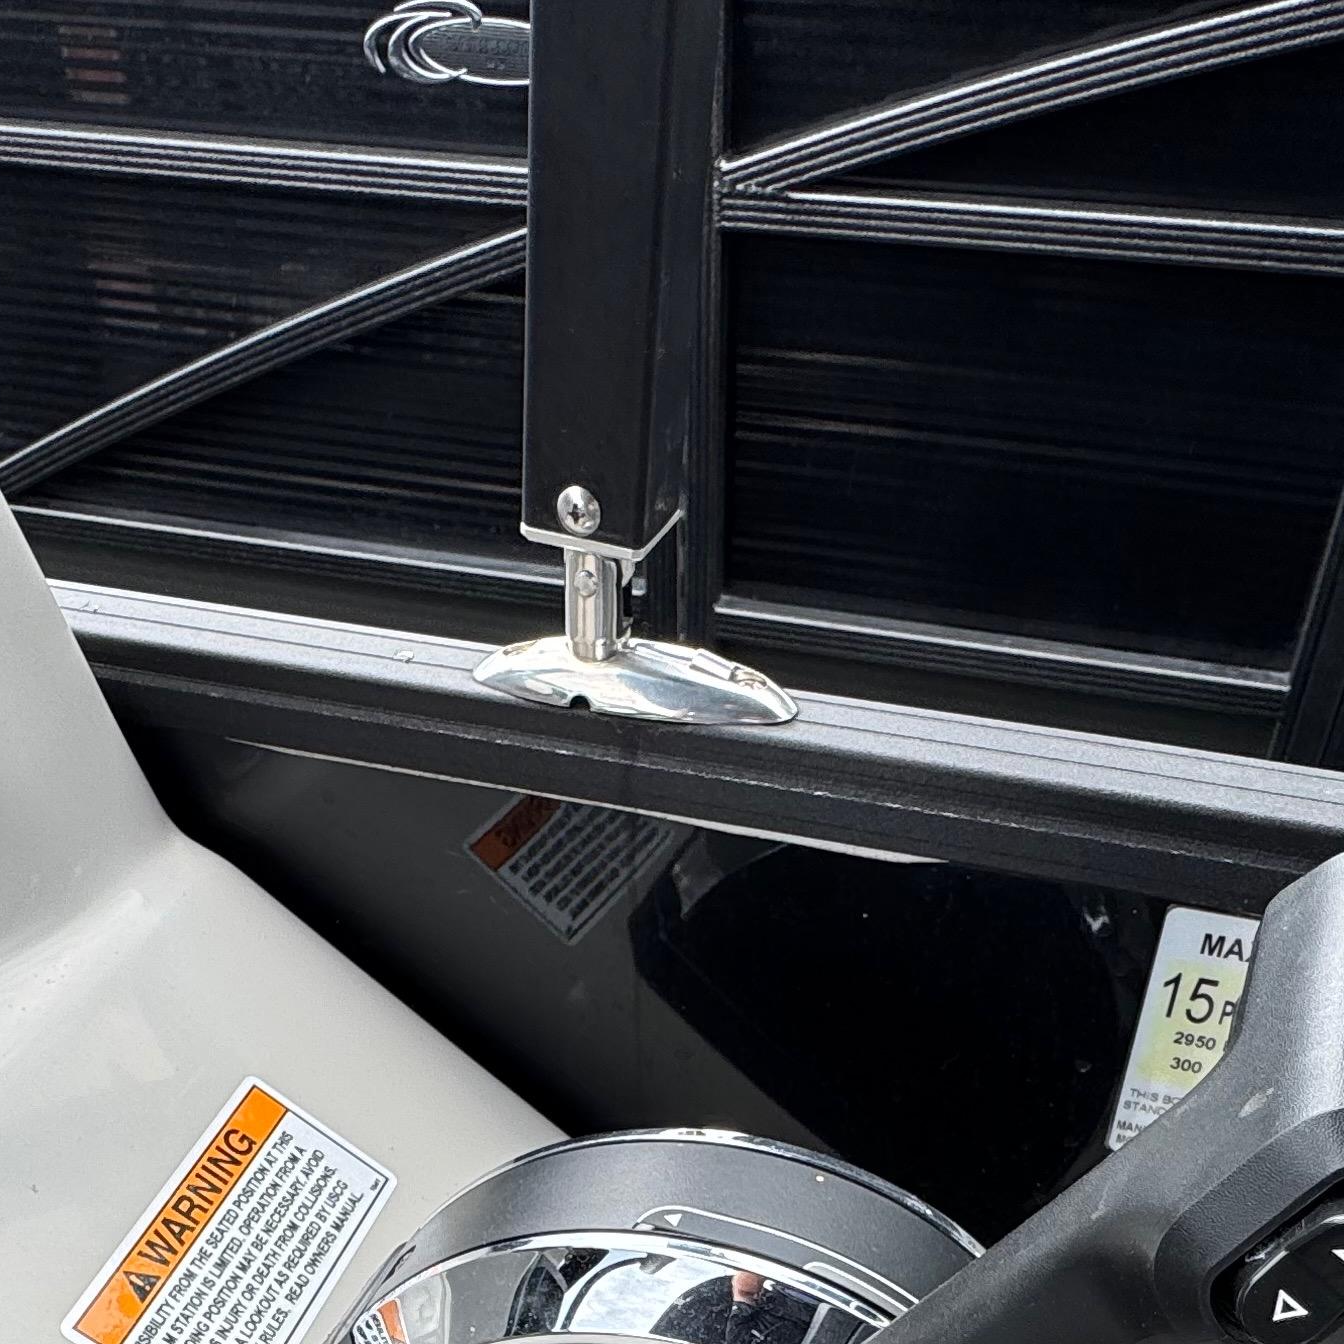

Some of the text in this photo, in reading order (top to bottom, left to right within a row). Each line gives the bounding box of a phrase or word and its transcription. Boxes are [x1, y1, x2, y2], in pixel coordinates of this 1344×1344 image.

[1164, 972, 1220, 1024] 15
[1173, 1031, 1216, 1050] 2950
[1170, 1057, 1202, 1073] 300
[137, 1128, 257, 1267] WARNING
[168, 1268, 198, 1303] FROM
[190, 1246, 213, 1270] THE
[205, 1209, 239, 1249] SEATED
[232, 1163, 270, 1211] POSITION
[264, 1151, 278, 1168] AT
[271, 1131, 293, 1154] THIS
[170, 1287, 209, 1335] STATION
[200, 1276, 216, 1291] IS
[238, 1179, 282, 1236] OPERATION
[275, 1152, 301, 1183] FROM
[294, 1146, 307, 1156] A
[202, 1271, 243, 1323] POSITION
[235, 1248, 257, 1274] MAY
[250, 1233, 268, 1252] BE
[300, 1149, 325, 1180] AVOID
[240, 1284, 280, 1339] LOOKOUT
[274, 1270, 290, 1289] AS
[282, 1221, 322, 1273] REQUIRED
[314, 1205, 331, 1223] BY
[324, 1179, 348, 1209] USCG
[215, 1298, 247, 1340] INJURY
[241, 1283, 259, 1301] OR
[251, 1248, 281, 1286] DEATH
[274, 1220, 300, 1252] FROM
[284, 1274, 310, 1305] READ
[304, 1231, 337, 1275] OWNERS
